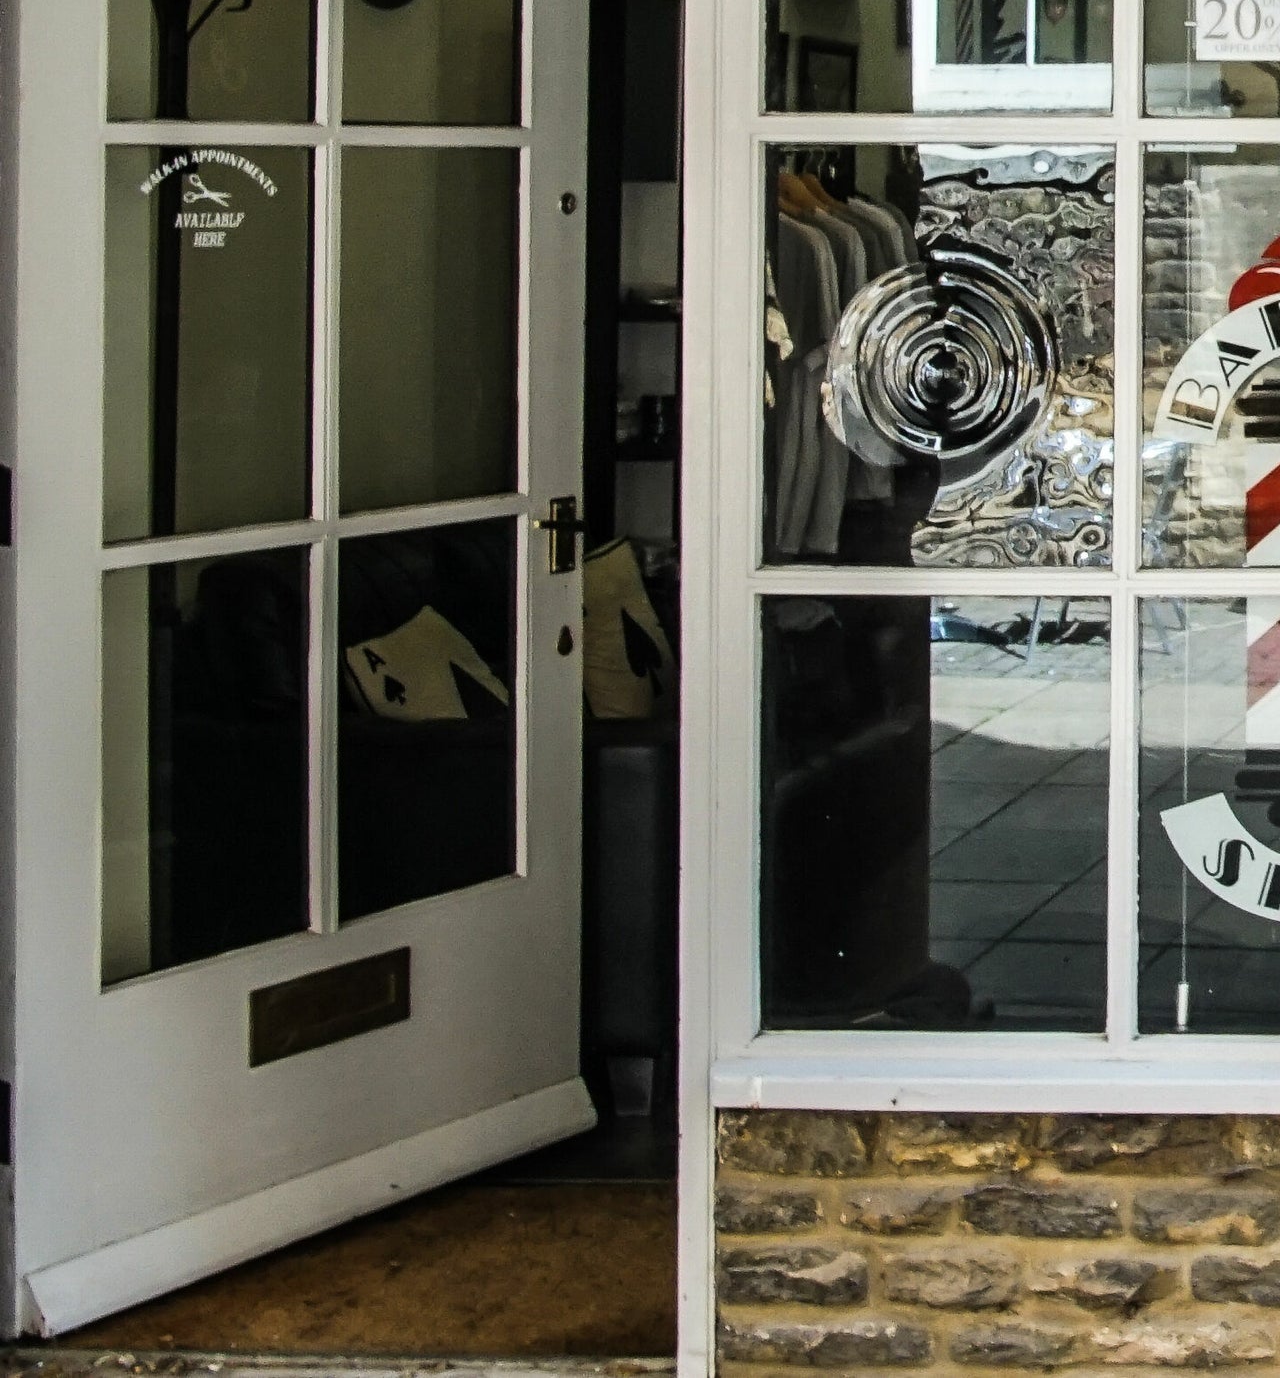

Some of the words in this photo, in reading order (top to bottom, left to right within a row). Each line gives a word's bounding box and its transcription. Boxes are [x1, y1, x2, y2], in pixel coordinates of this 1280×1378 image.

[140, 154, 188, 194] WALK-IN
[191, 149, 278, 197] APPOINTMENTS
[193, 231, 226, 247] HERE
